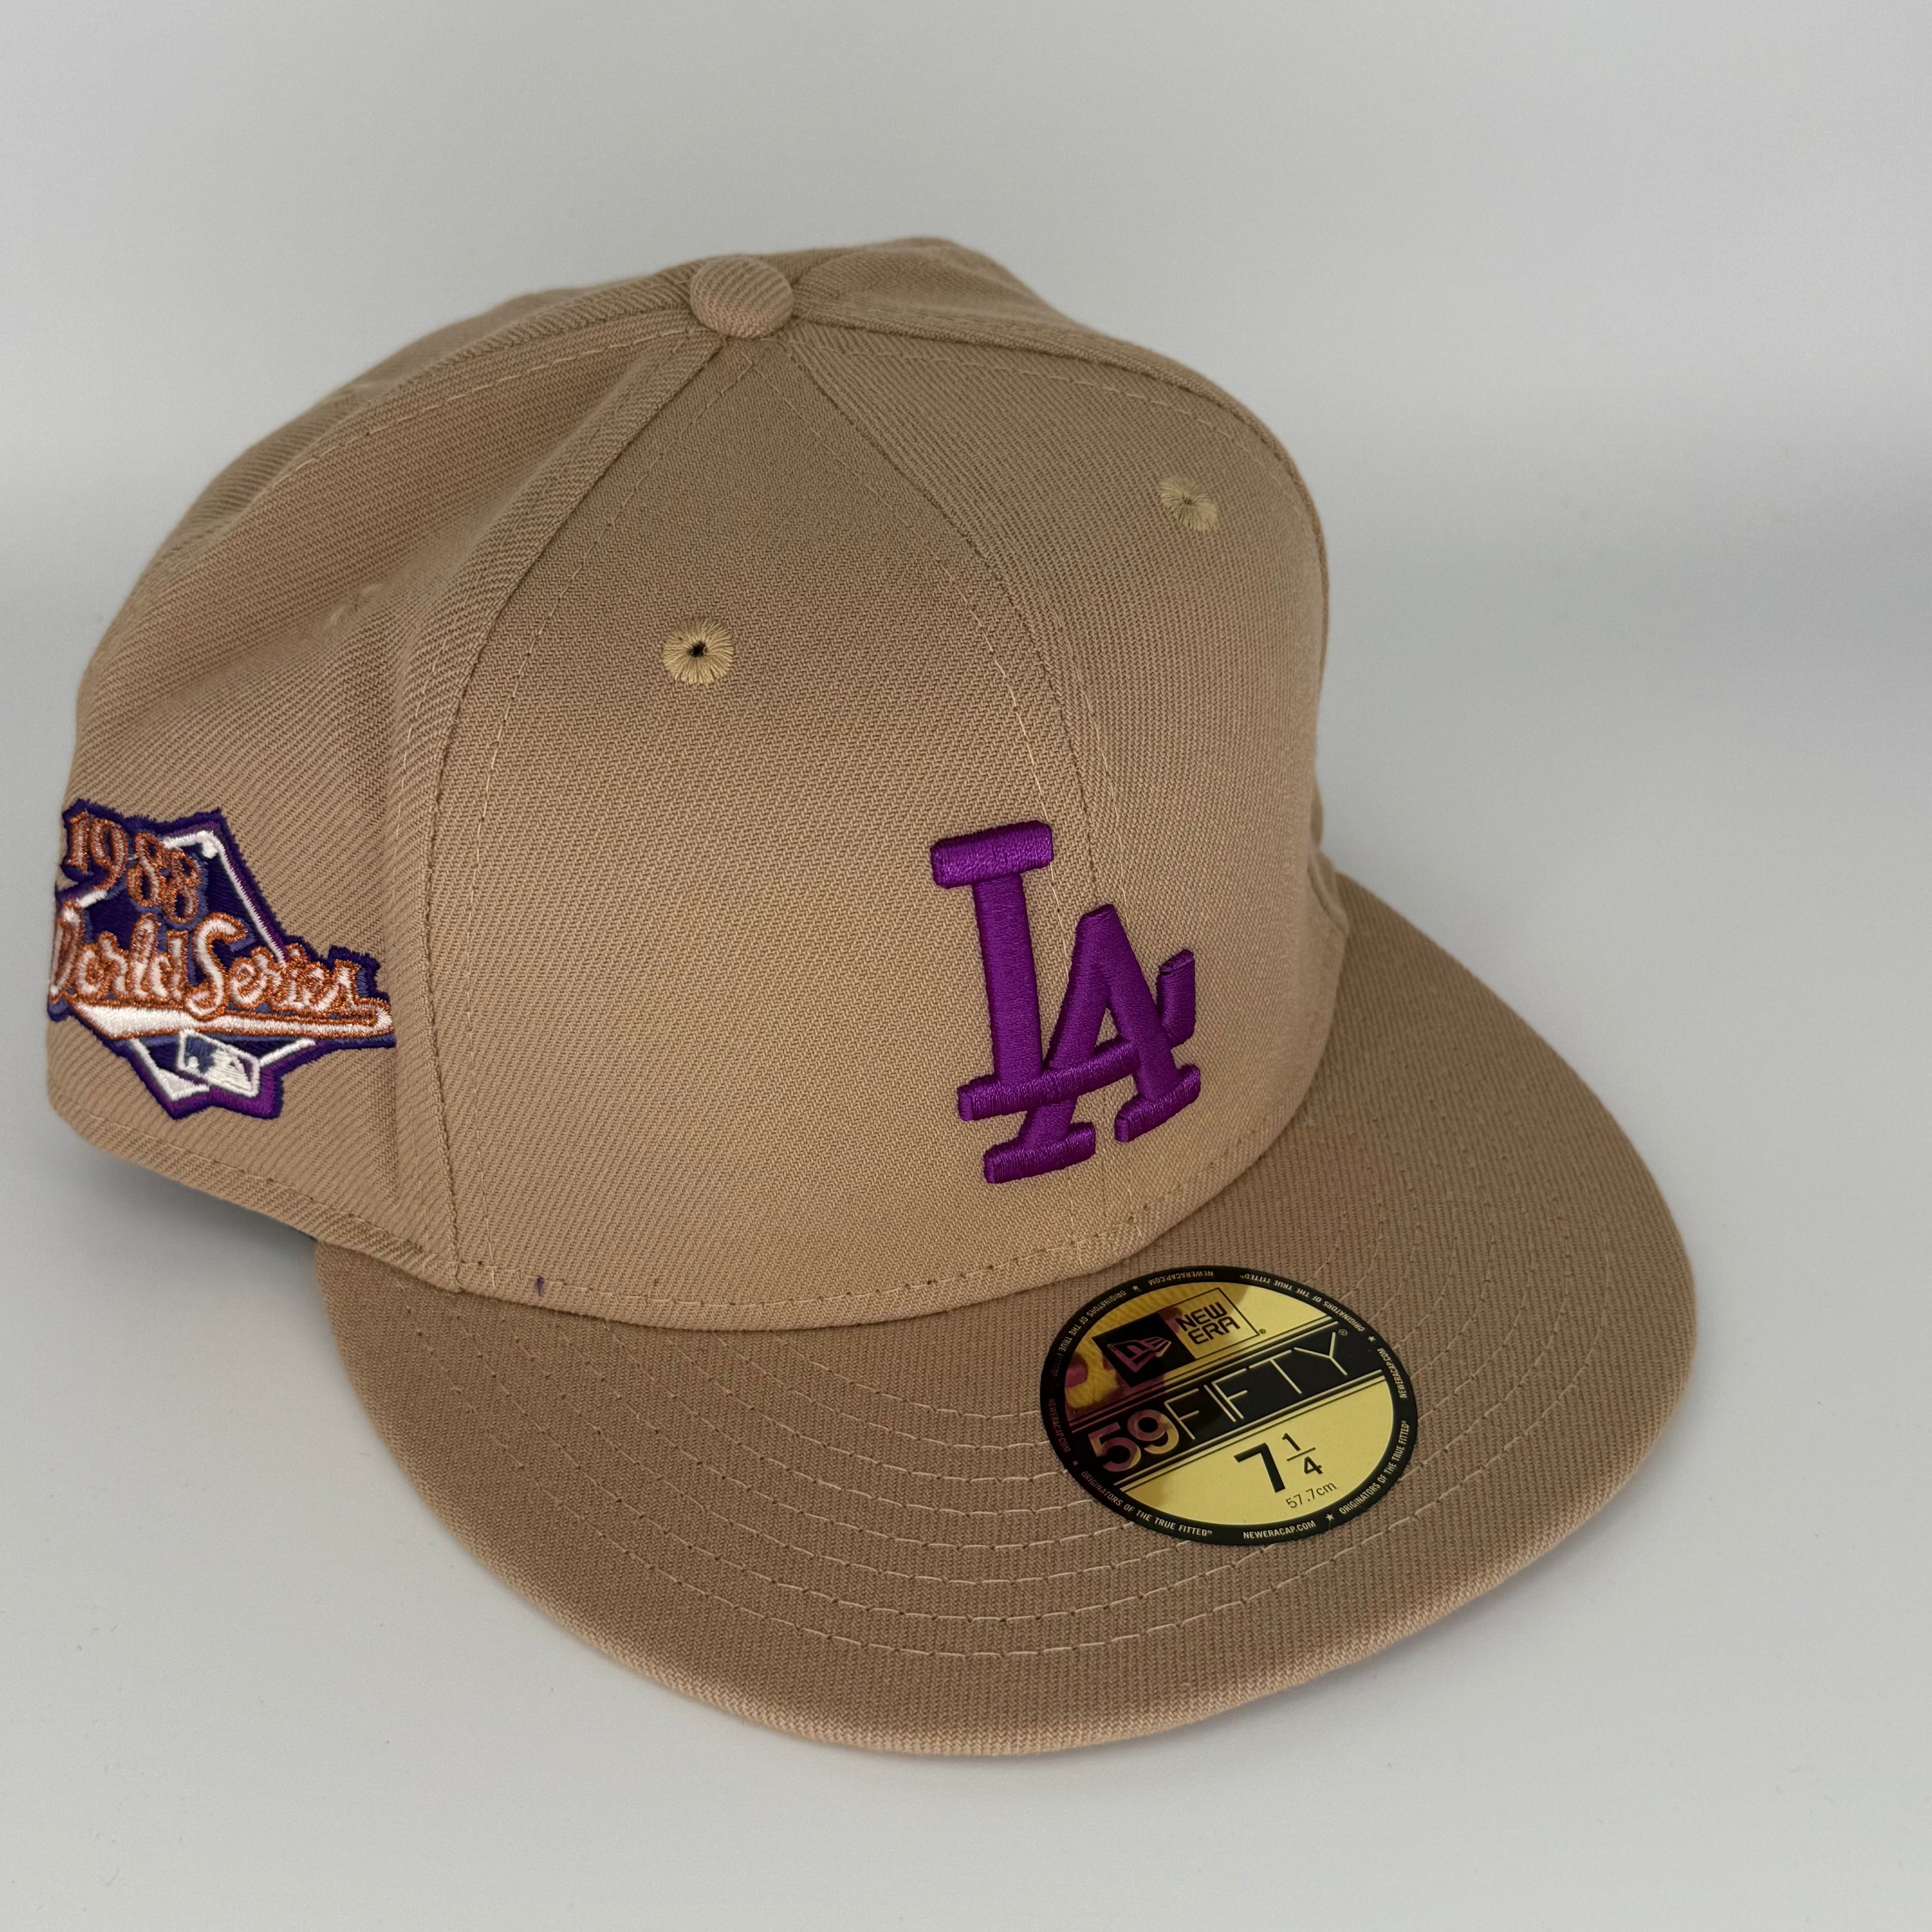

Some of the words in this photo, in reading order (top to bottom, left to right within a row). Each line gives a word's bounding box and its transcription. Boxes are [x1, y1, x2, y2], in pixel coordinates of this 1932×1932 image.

[61, 809, 201, 924] 1988
[183, 912, 361, 1022] Series
[931, 820, 1200, 1184] LA
[1148, 1271, 1214, 1285] NEWERACAP.COM
[1273, 1281, 1292, 1291] TRUE
[1086, 1290, 1126, 1317] ORIGINATORS
[1296, 1287, 1310, 1298] THE
[1069, 1324, 1081, 1336] THE
[1079, 1316, 1088, 1325] OF
[1175, 1302, 1227, 1331] NEW
[1187, 1316, 1240, 1344] ERA
[1322, 1301, 1365, 1332] ORIGINATORS
[1059, 1336, 1072, 1352] TRUE
[1377, 1347, 1407, 1398] NEWERACAP.COM
[1339, 1483, 1381, 1514] ORIGINATORS
[1379, 1474, 1387, 1483] OF
[1384, 1462, 1397, 1474] THE
[1391, 1445, 1405, 1462] TRUE
[1081, 1471, 1123, 1506] ORIGINATORS
[1123, 1504, 1135, 1512] OF
[1136, 1509, 1153, 1521] THE
[1154, 1517, 1176, 1530] TRUE
[1285, 1483, 1337, 1508] 57.7cm
[1243, 1520, 1316, 1539] NEWERACAP.COM
